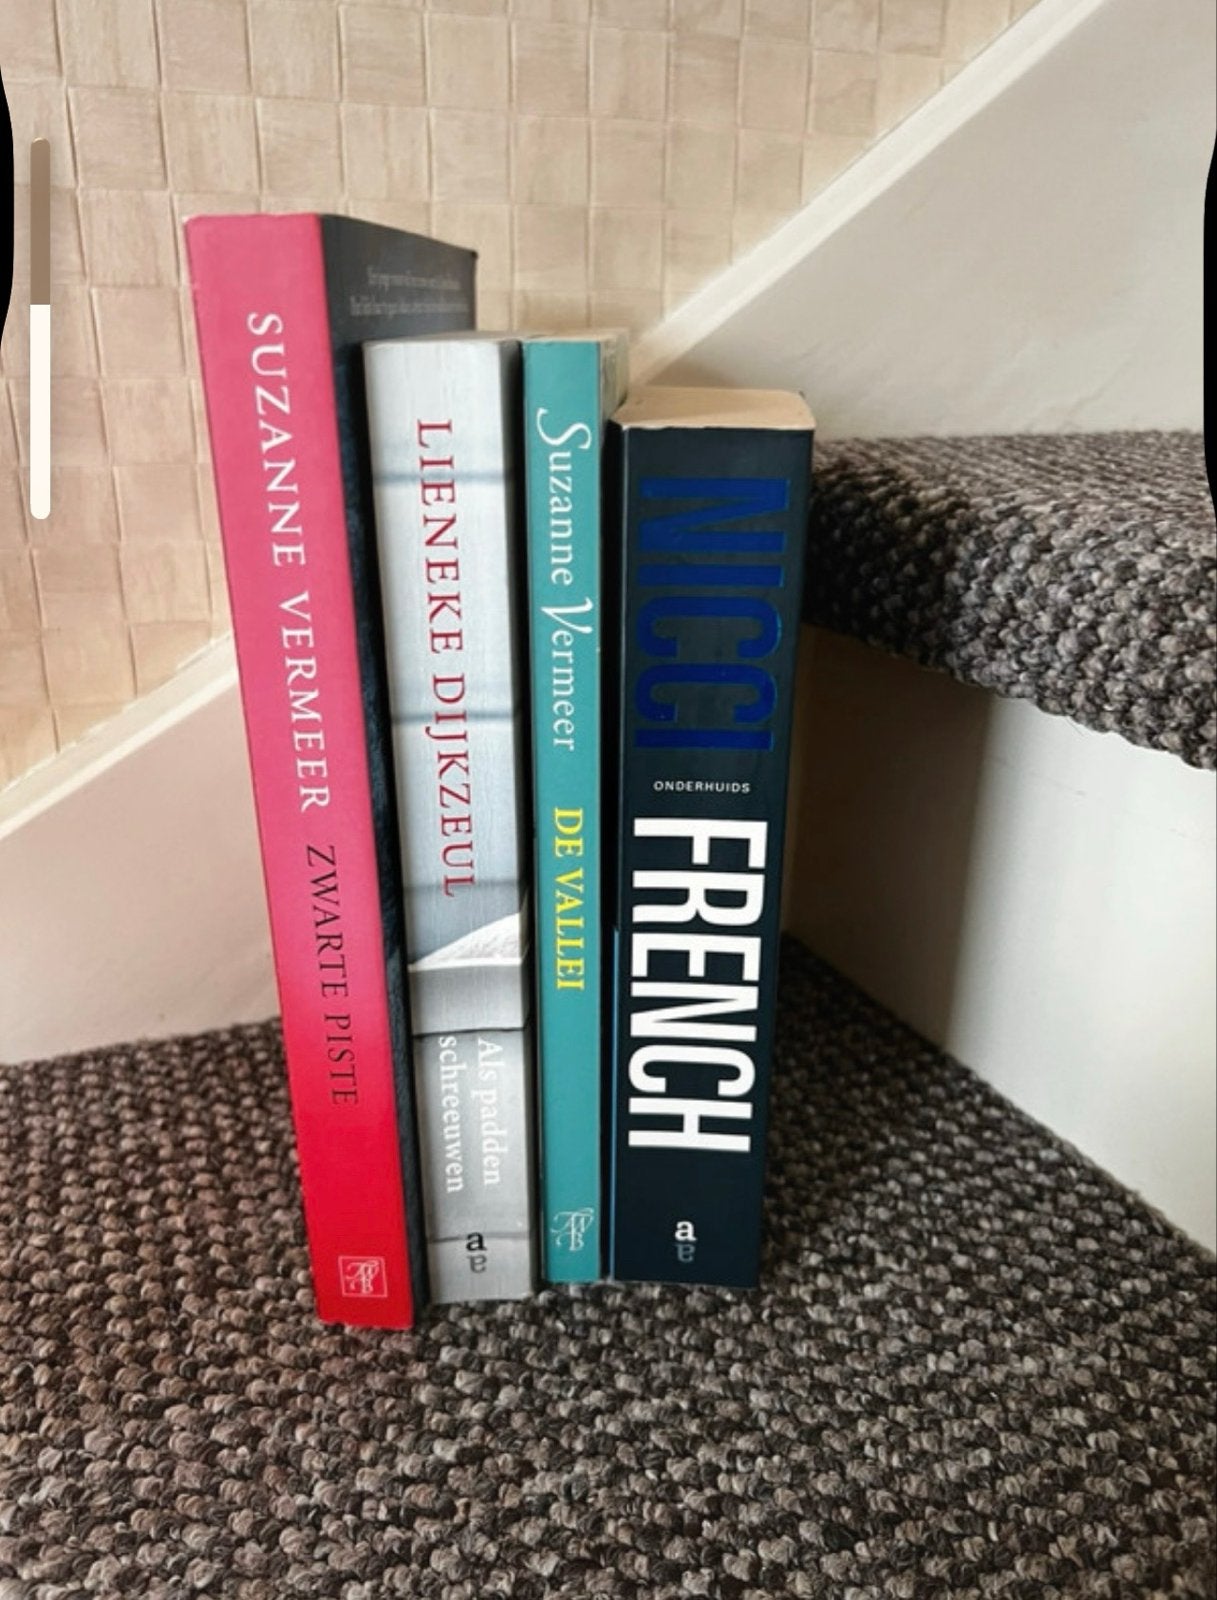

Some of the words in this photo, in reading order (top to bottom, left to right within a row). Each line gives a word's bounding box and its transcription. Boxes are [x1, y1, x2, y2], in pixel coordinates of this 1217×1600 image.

[248, 312, 306, 566] SUZANNE
[279, 590, 331, 813] VERMEER
[416, 419, 464, 654] LIENEKE
[535, 407, 592, 586] Suzanne
[540, 596, 594, 752] Vermeer
[634, 477, 791, 750] NICCI
[425, 673, 476, 898] DIJKZEUL
[554, 807, 584, 858] DE
[653, 780, 751, 794] ONDERHUIDS
[306, 845, 349, 998] ZWARTE
[554, 867, 586, 990] VALLEI
[627, 817, 768, 1152] FRENCH
[324, 1013, 358, 1106] PISTE
[438, 1035, 467, 1193] schreeuwen
[471, 1087, 508, 1186] padden
[477, 1038, 505, 1084] Als
